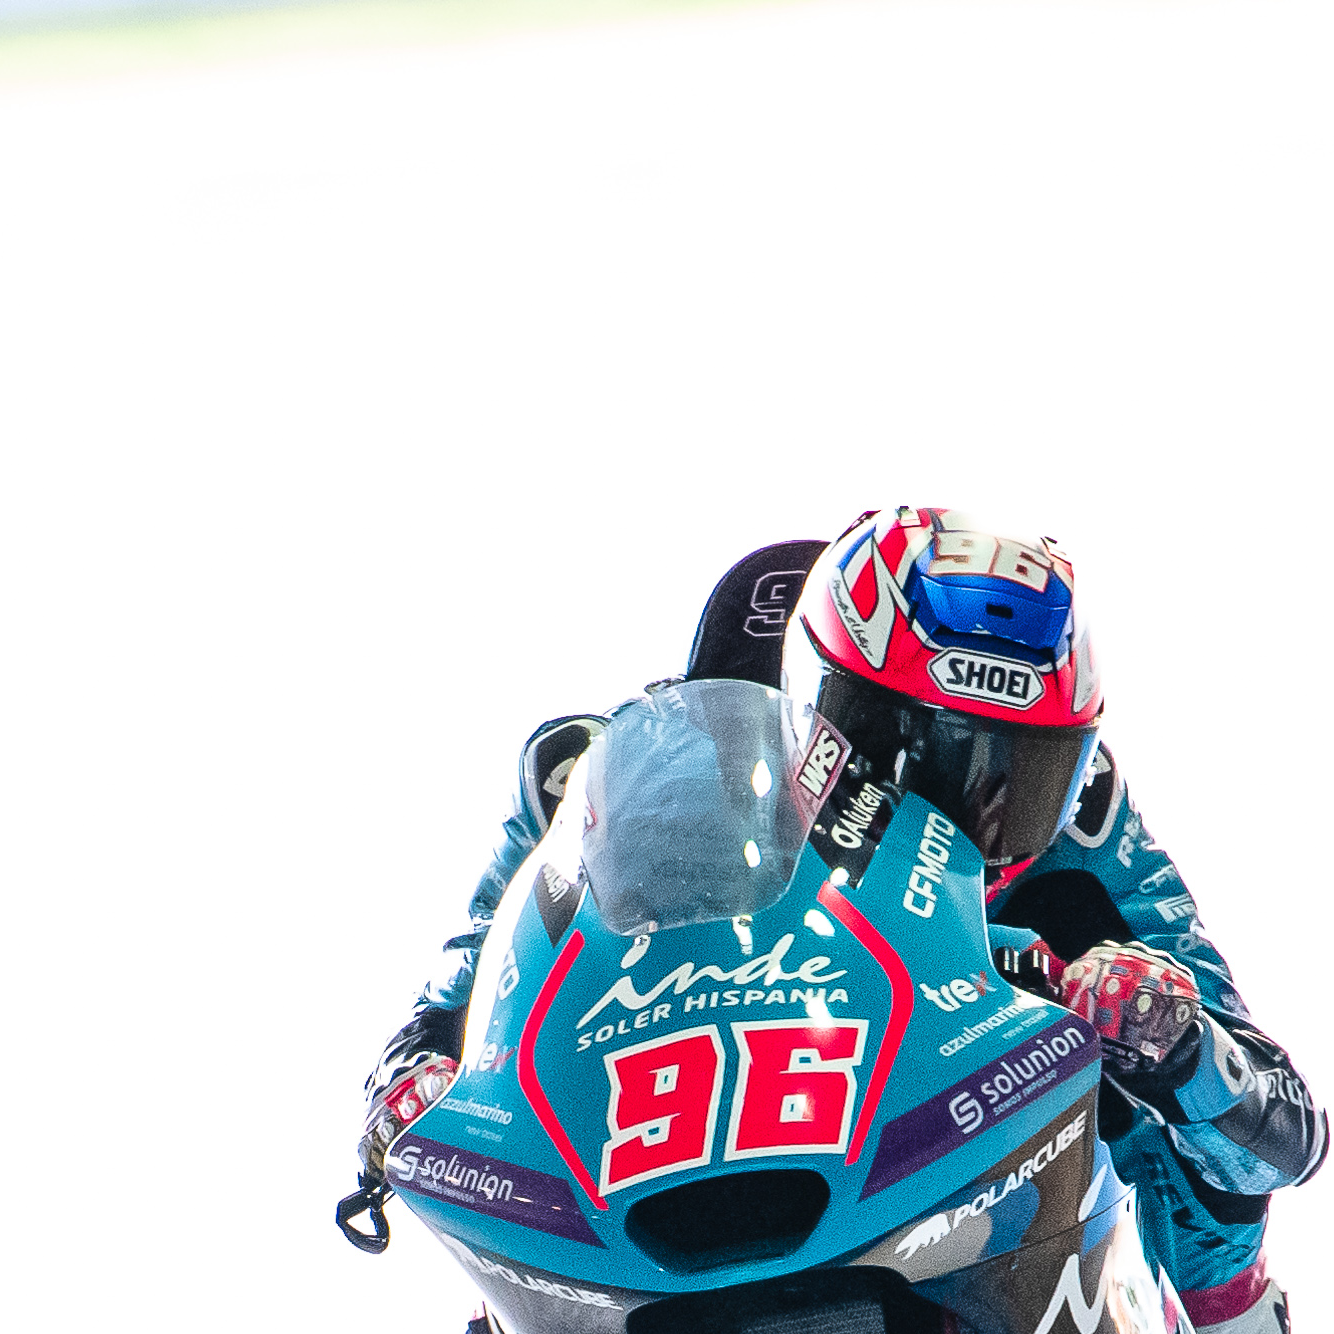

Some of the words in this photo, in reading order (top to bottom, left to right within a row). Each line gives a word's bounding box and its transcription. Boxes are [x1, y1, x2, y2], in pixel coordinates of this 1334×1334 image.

[928, 531, 1053, 593] 96
[946, 657, 1031, 701] SHOEI
[798, 728, 841, 800] WRS
[902, 811, 957, 919] CFMOTO
[575, 933, 848, 1031] inde
[575, 1002, 672, 1053] SOLER
[683, 987, 849, 1014] HISPANIA
[980, 1026, 1086, 1104] solunion
[598, 1018, 869, 1198] 96
[952, 1109, 1088, 1232] POLARCUBE
